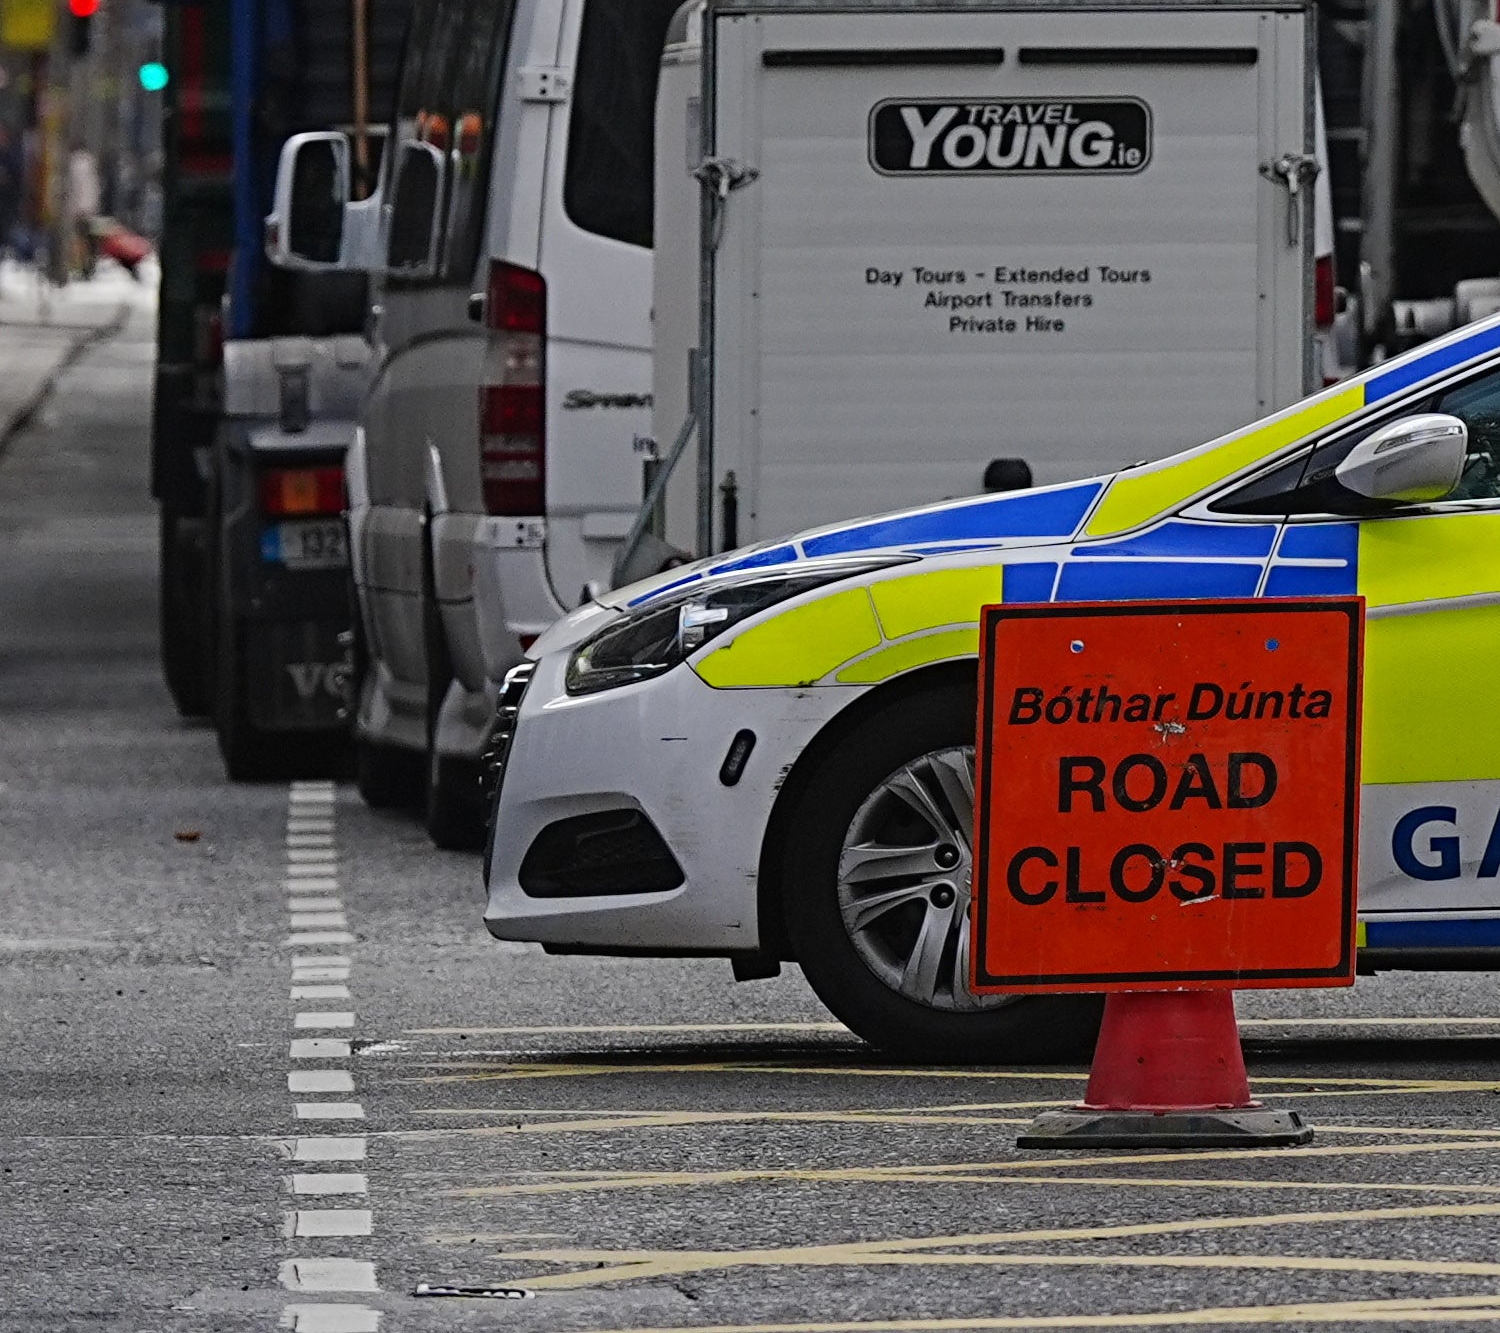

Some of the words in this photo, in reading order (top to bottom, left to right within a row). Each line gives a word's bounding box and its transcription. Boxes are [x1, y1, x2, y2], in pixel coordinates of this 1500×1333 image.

[964, 105, 1081, 124] TRAVEL
[865, 268, 903, 284] Day
[911, 267, 965, 284] Tours
[994, 267, 1090, 283] Extended
[1098, 267, 1151, 283] Tours
[924, 291, 993, 310] Airport
[1002, 290, 1093, 308] Transfers
[949, 315, 1017, 333] Private
[1025, 316, 1065, 332] Hire
[1008, 685, 1175, 726] Bóthar
[1187, 683, 1333, 721] Dúnta
[1057, 752, 1278, 814] ROAD
[1005, 841, 1323, 907] CLOSED
